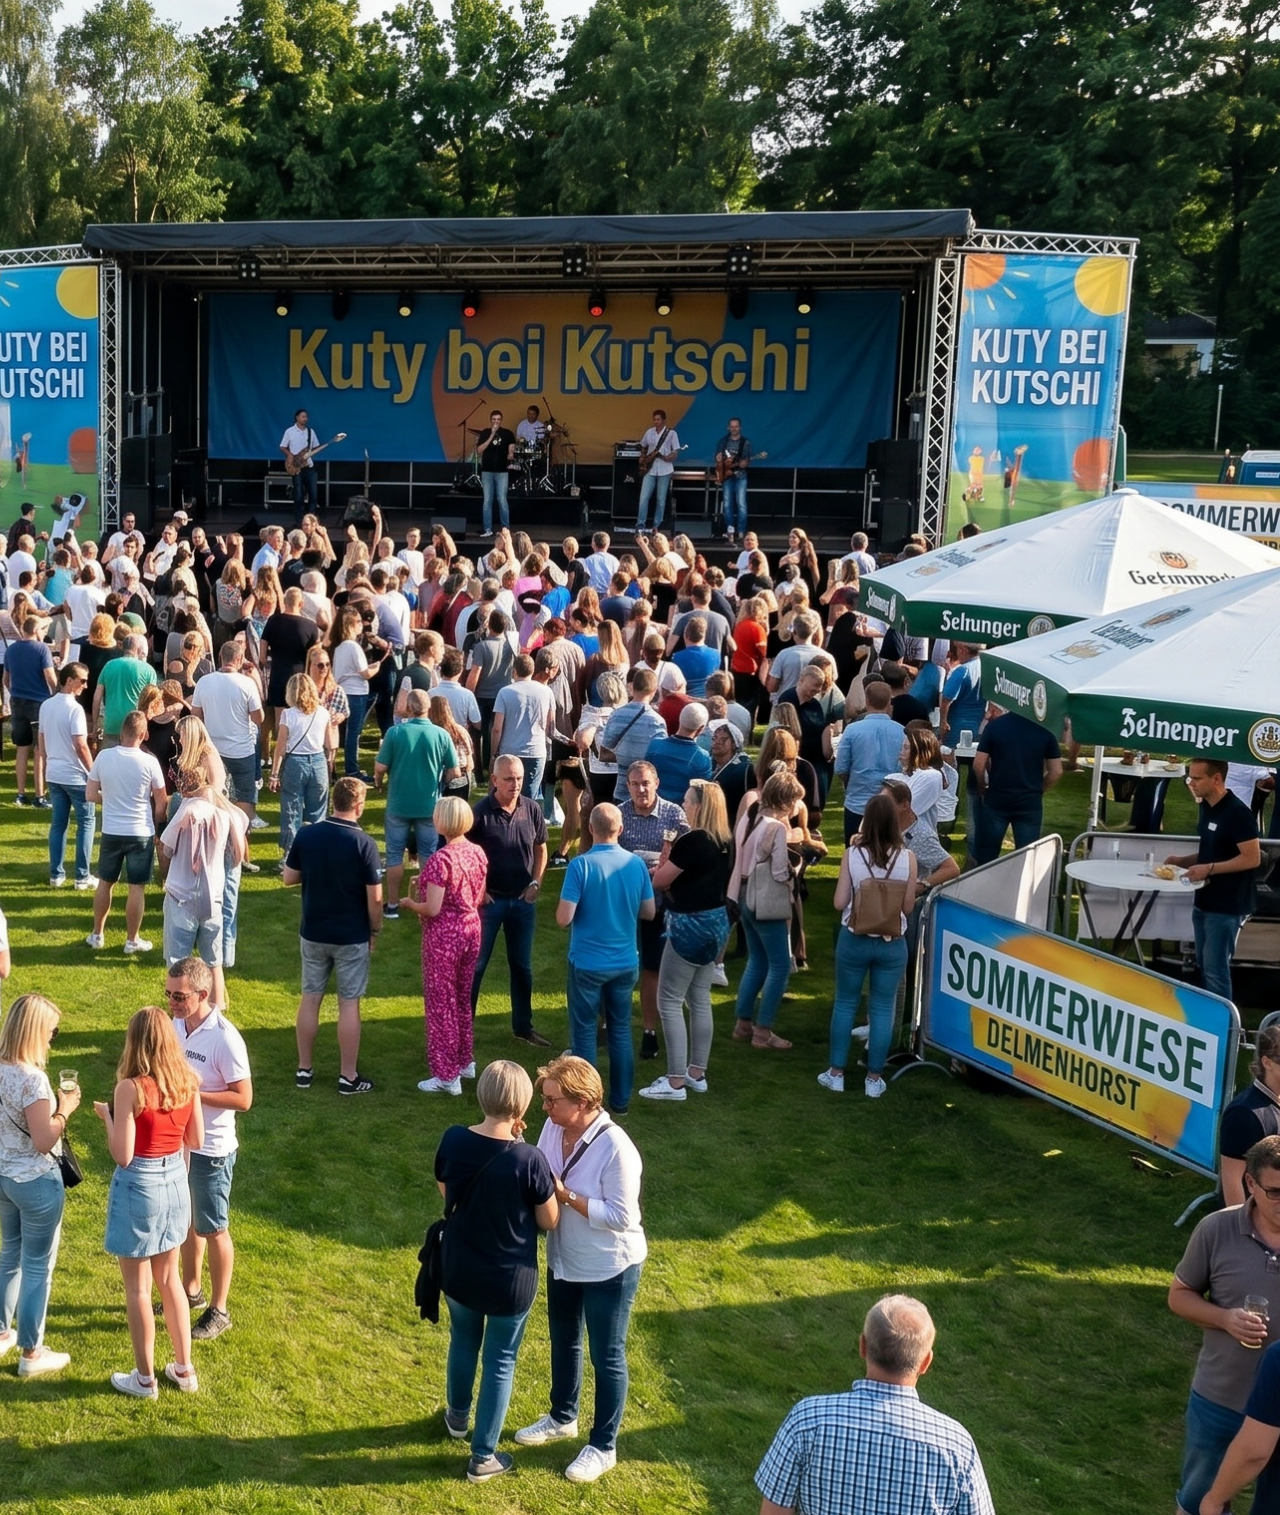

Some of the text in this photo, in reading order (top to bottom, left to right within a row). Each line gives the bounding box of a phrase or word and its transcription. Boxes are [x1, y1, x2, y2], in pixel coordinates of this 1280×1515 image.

[50, 332, 87, 362] BEI
[971, 328, 1107, 365] KUTY BEI
[289, 328, 810, 403] Kuty bei Kutschi
[971, 369, 1101, 406] KUTSCHI
[1161, 502, 1280, 533] MMERW
[947, 943, 1207, 1095] SOMMERWIESE
[987, 1017, 1141, 1111] DELMENHORST
